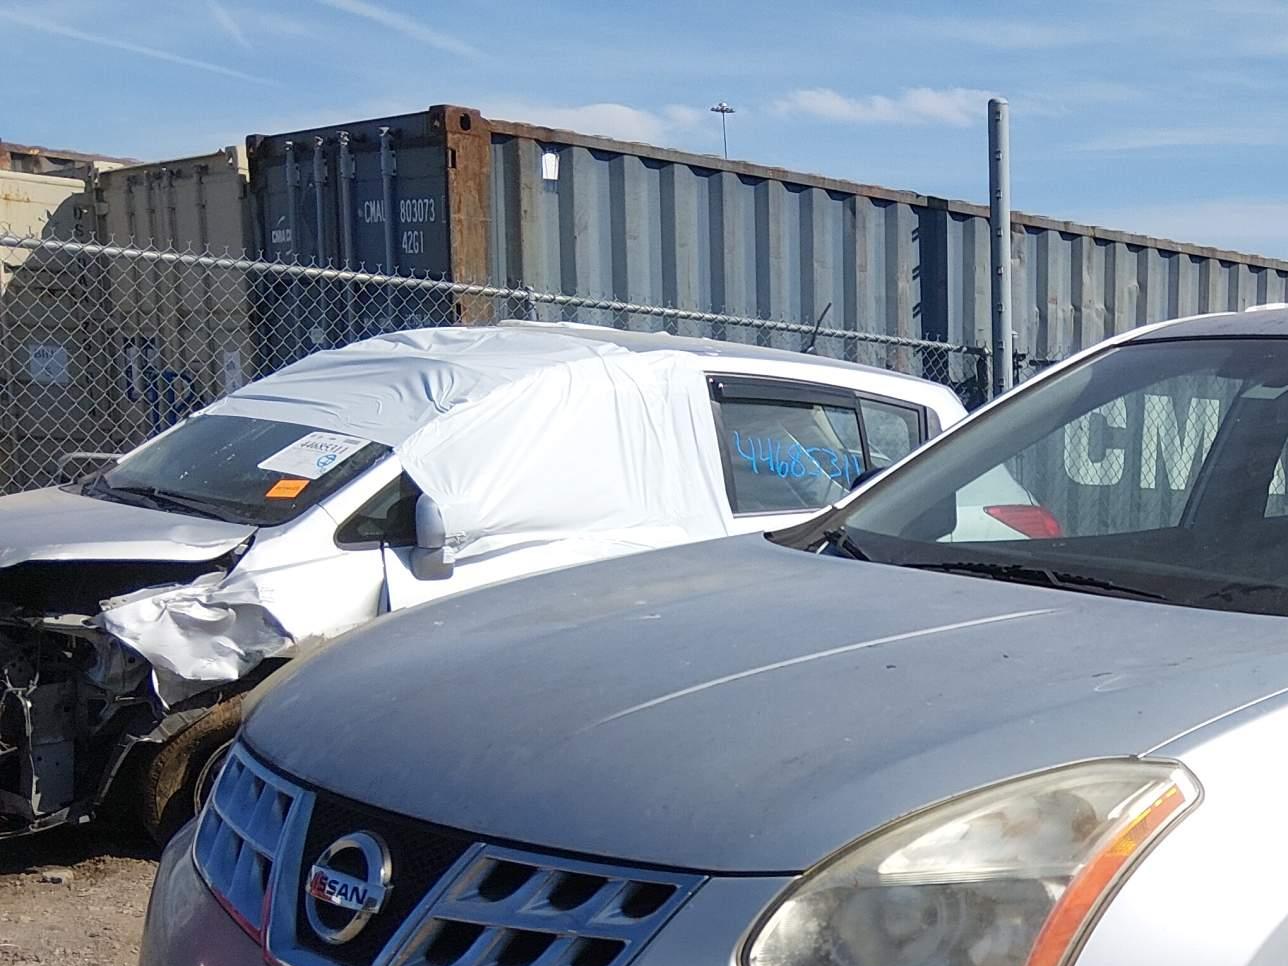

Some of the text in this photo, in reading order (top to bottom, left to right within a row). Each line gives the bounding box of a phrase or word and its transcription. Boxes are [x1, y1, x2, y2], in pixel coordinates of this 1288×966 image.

[399, 198, 435, 223] 803073
[402, 230, 424, 254] 42G1
[1063, 392, 1222, 491] CM
